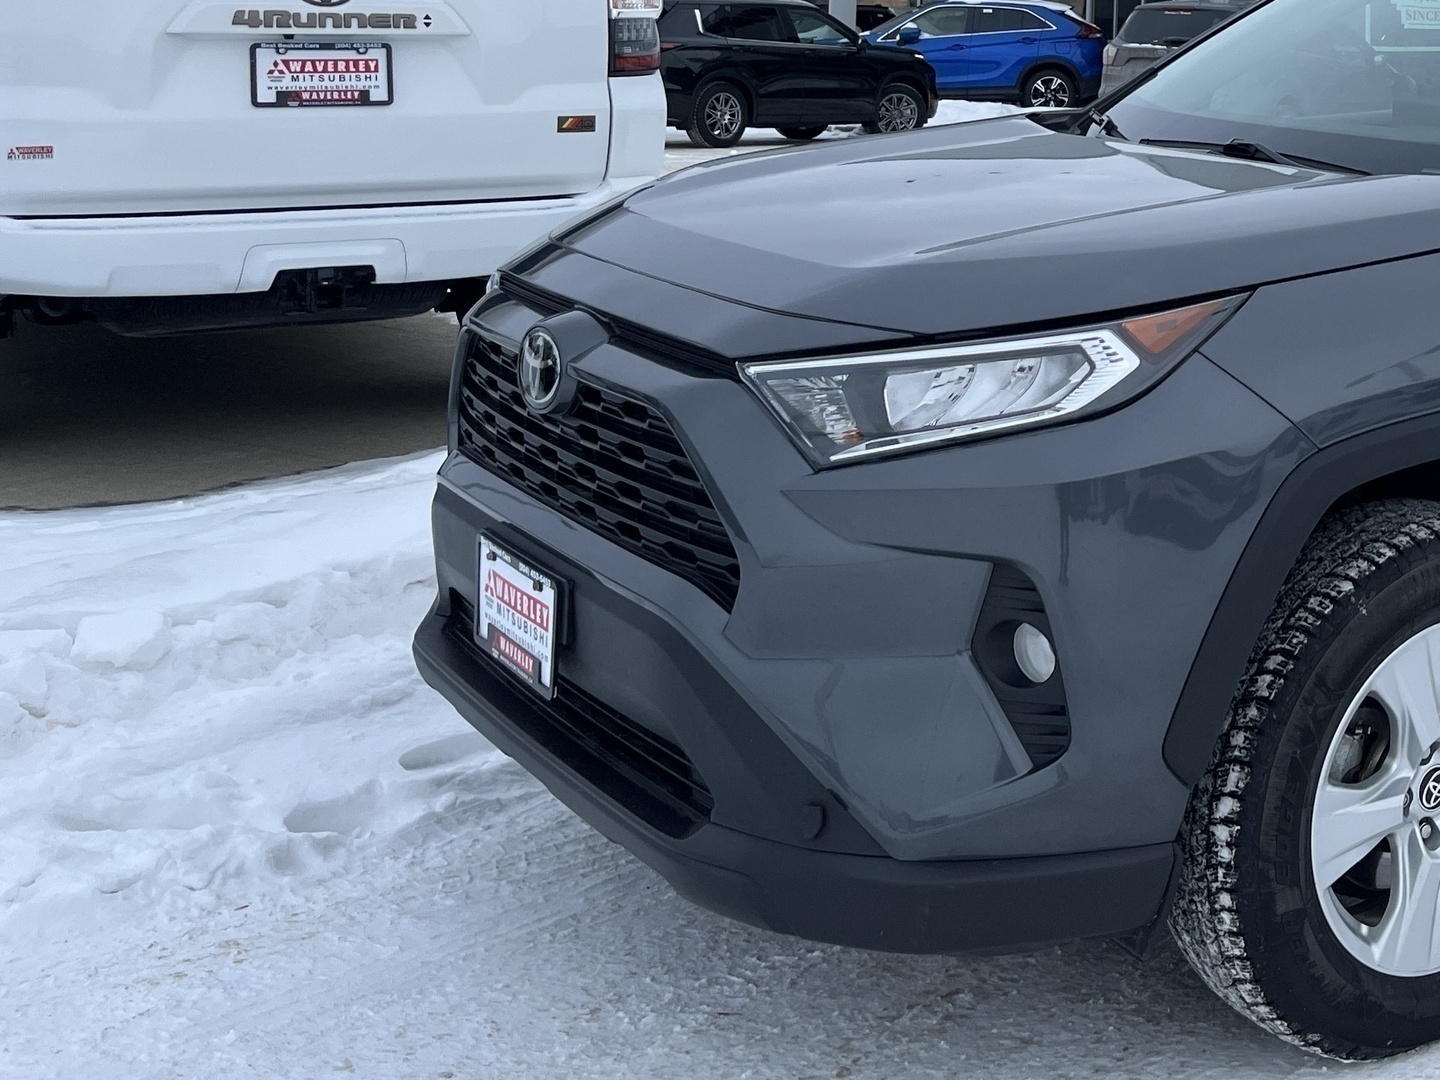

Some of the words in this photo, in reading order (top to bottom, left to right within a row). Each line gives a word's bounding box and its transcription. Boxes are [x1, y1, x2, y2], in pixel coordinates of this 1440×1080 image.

[1405, 9, 1440, 21] SINCE
[289, 60, 377, 72] WAVERLEY
[291, 74, 379, 83] MITSUBISHI
[301, 91, 360, 100] WAVERLEY
[496, 575, 549, 629] WAVERLEY
[496, 602, 549, 648] MITSUBISHI
[500, 635, 534, 673] WAVERLEY
